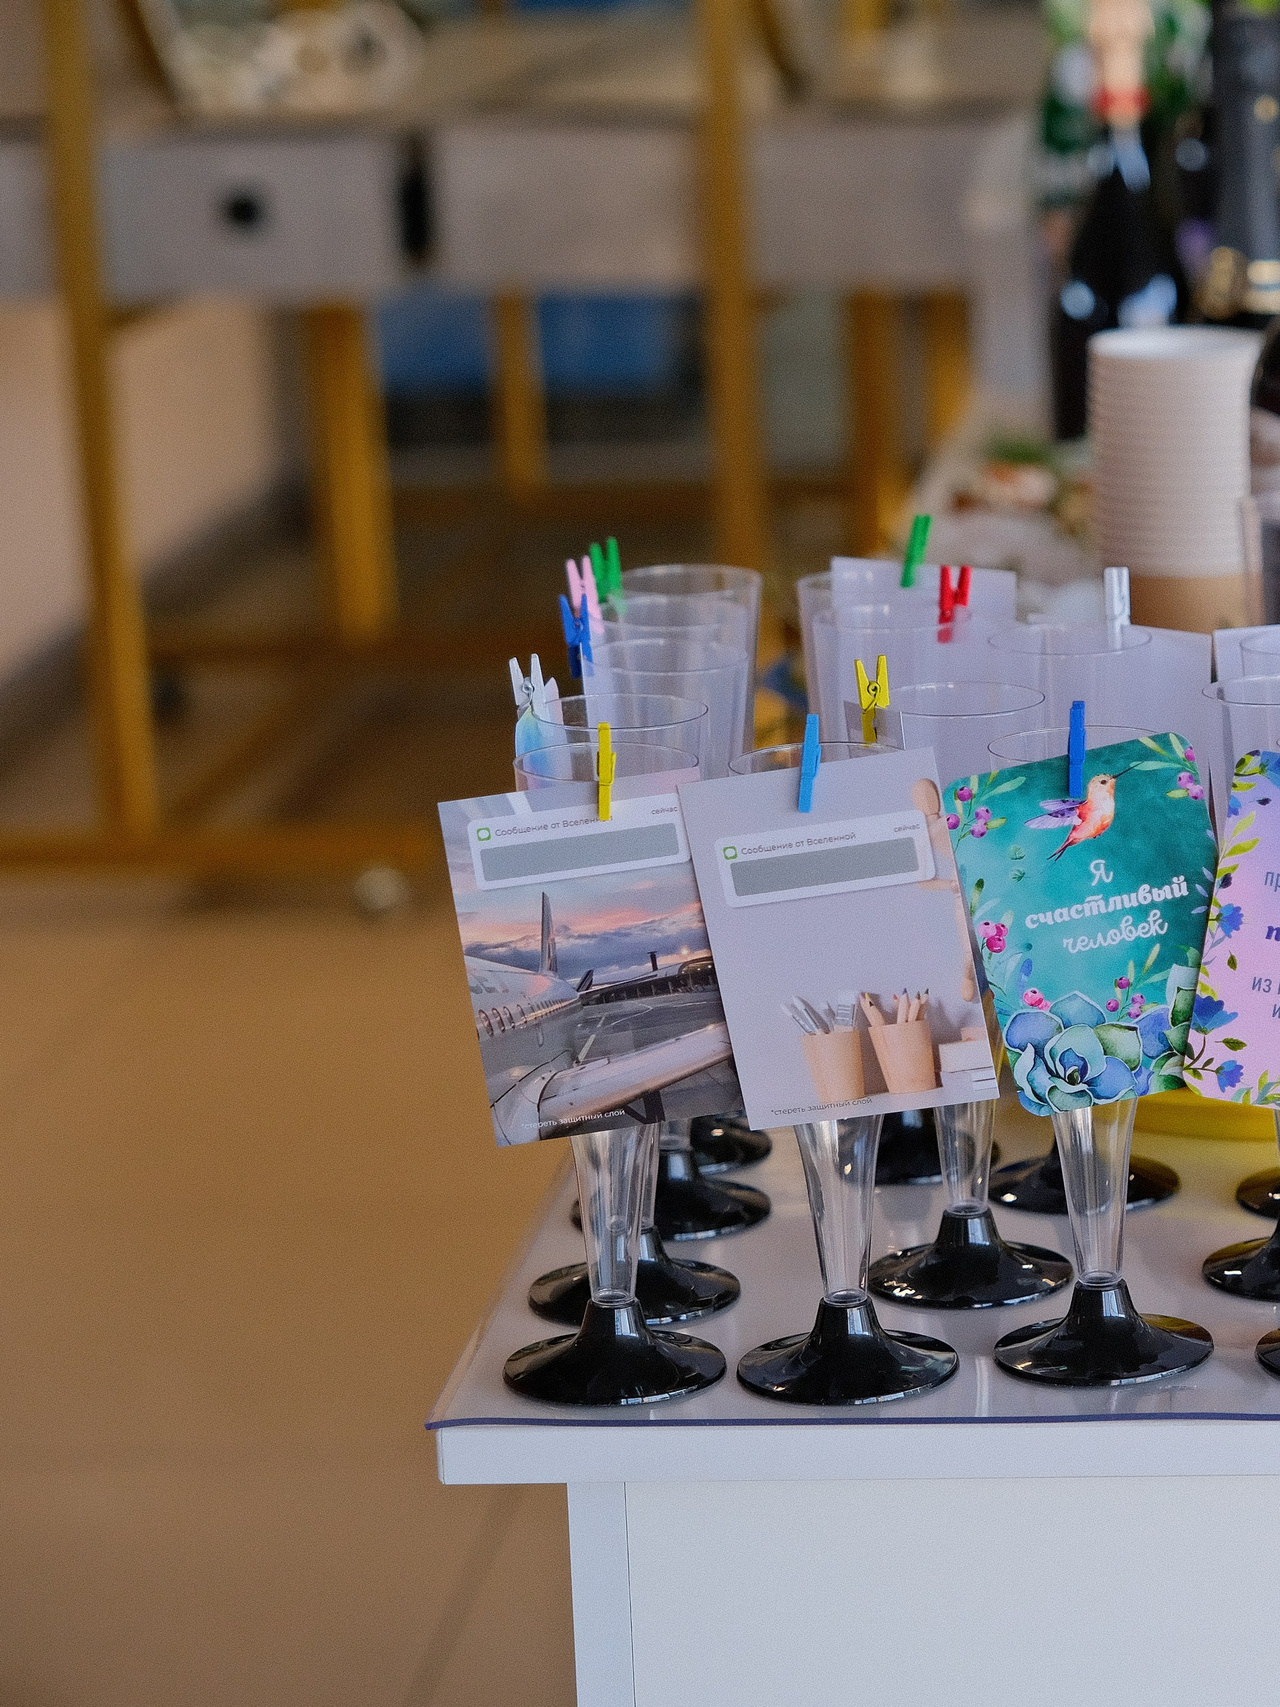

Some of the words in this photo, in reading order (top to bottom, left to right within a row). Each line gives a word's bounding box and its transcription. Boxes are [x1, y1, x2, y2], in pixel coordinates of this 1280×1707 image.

[494, 822, 549, 837] Сообщение
[550, 821, 561, 830] от
[740, 841, 794, 856] Сообщение
[795, 839, 805, 848] от
[806, 831, 857, 846] Вселенной
[1089, 858, 1114, 887] Я
[1025, 874, 1190, 929] счастливый
[1062, 909, 1169, 954] человек
[1251, 976, 1273, 993] из
[807, 1099, 851, 1112] защитный
[852, 1097, 873, 1106] слой
[559, 1111, 603, 1125] защитный
[604, 1107, 626, 1118] слой
